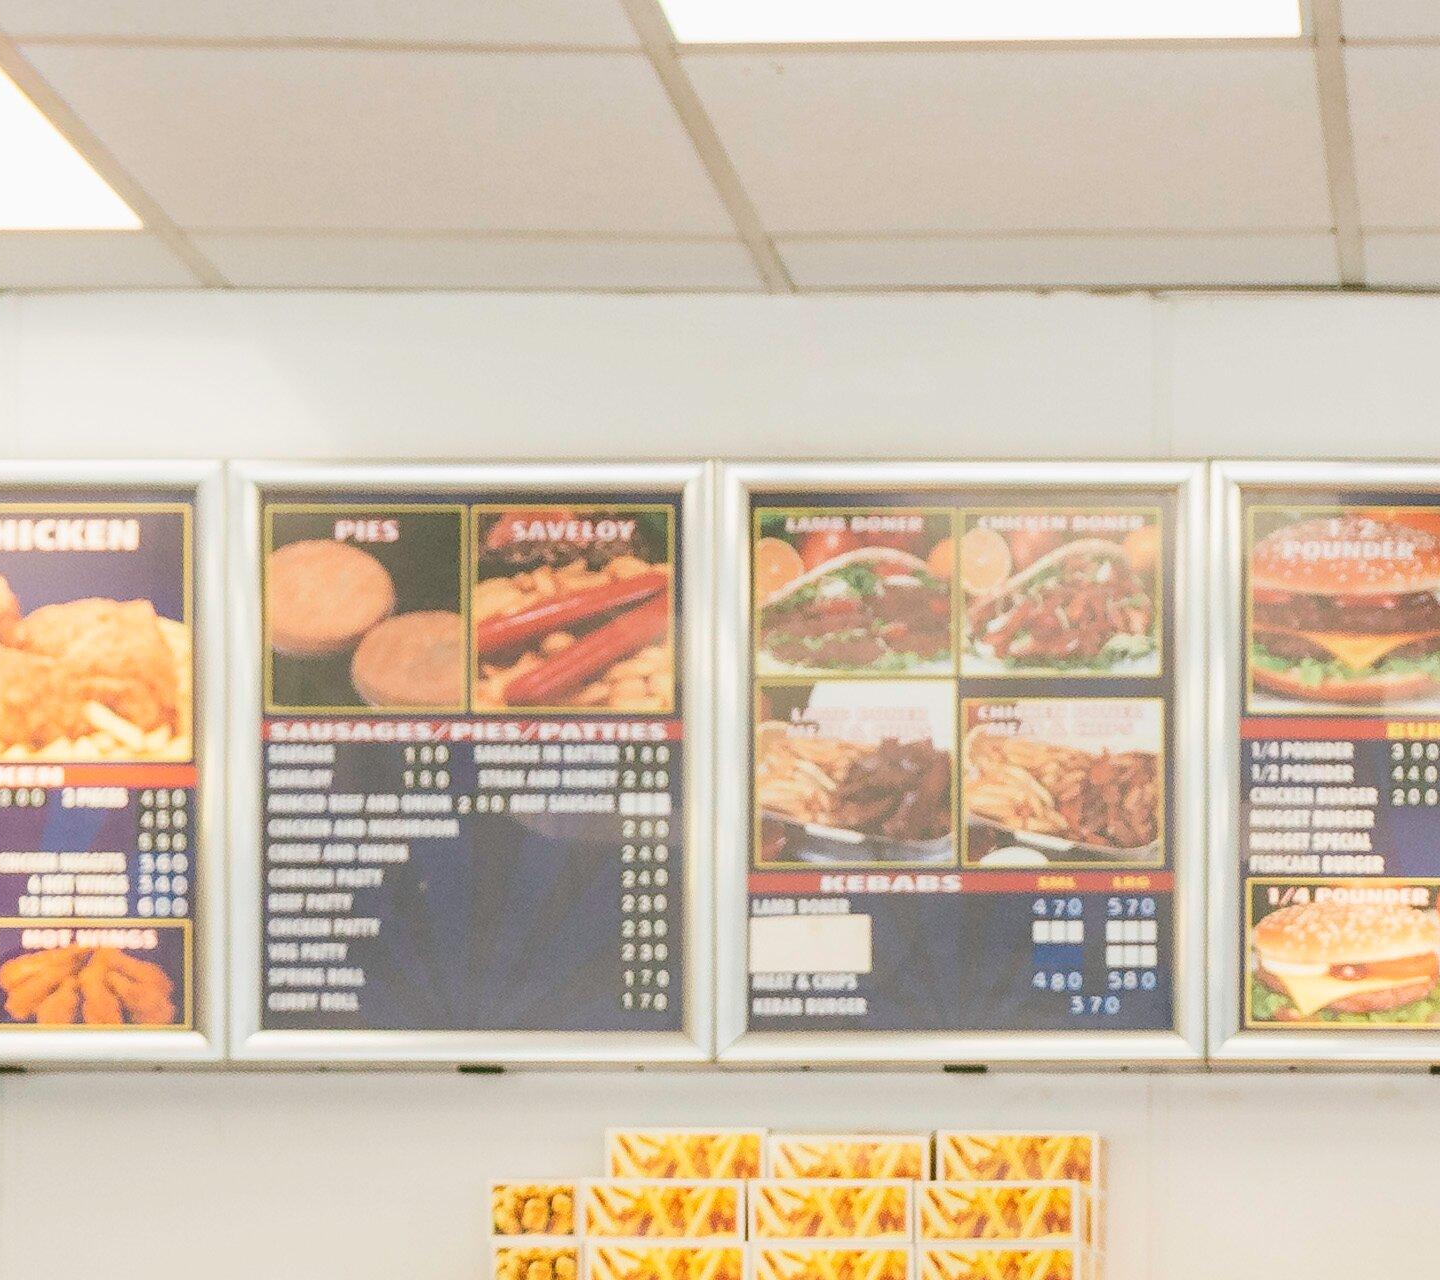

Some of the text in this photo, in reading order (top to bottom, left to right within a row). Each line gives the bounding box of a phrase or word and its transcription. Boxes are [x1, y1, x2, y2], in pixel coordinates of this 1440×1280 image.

[334, 519, 399, 541] PIES
[512, 520, 635, 541] SAVELOY
[1283, 541, 1415, 560] POUNDER
[1392, 742, 1440, 760] 300
[1392, 765, 1439, 783] 440
[1391, 787, 1439, 806] 200
[820, 873, 963, 892] KEBABS
[1033, 898, 1083, 915] 470
[1267, 888, 1430, 906] 1/4 POUNDER
